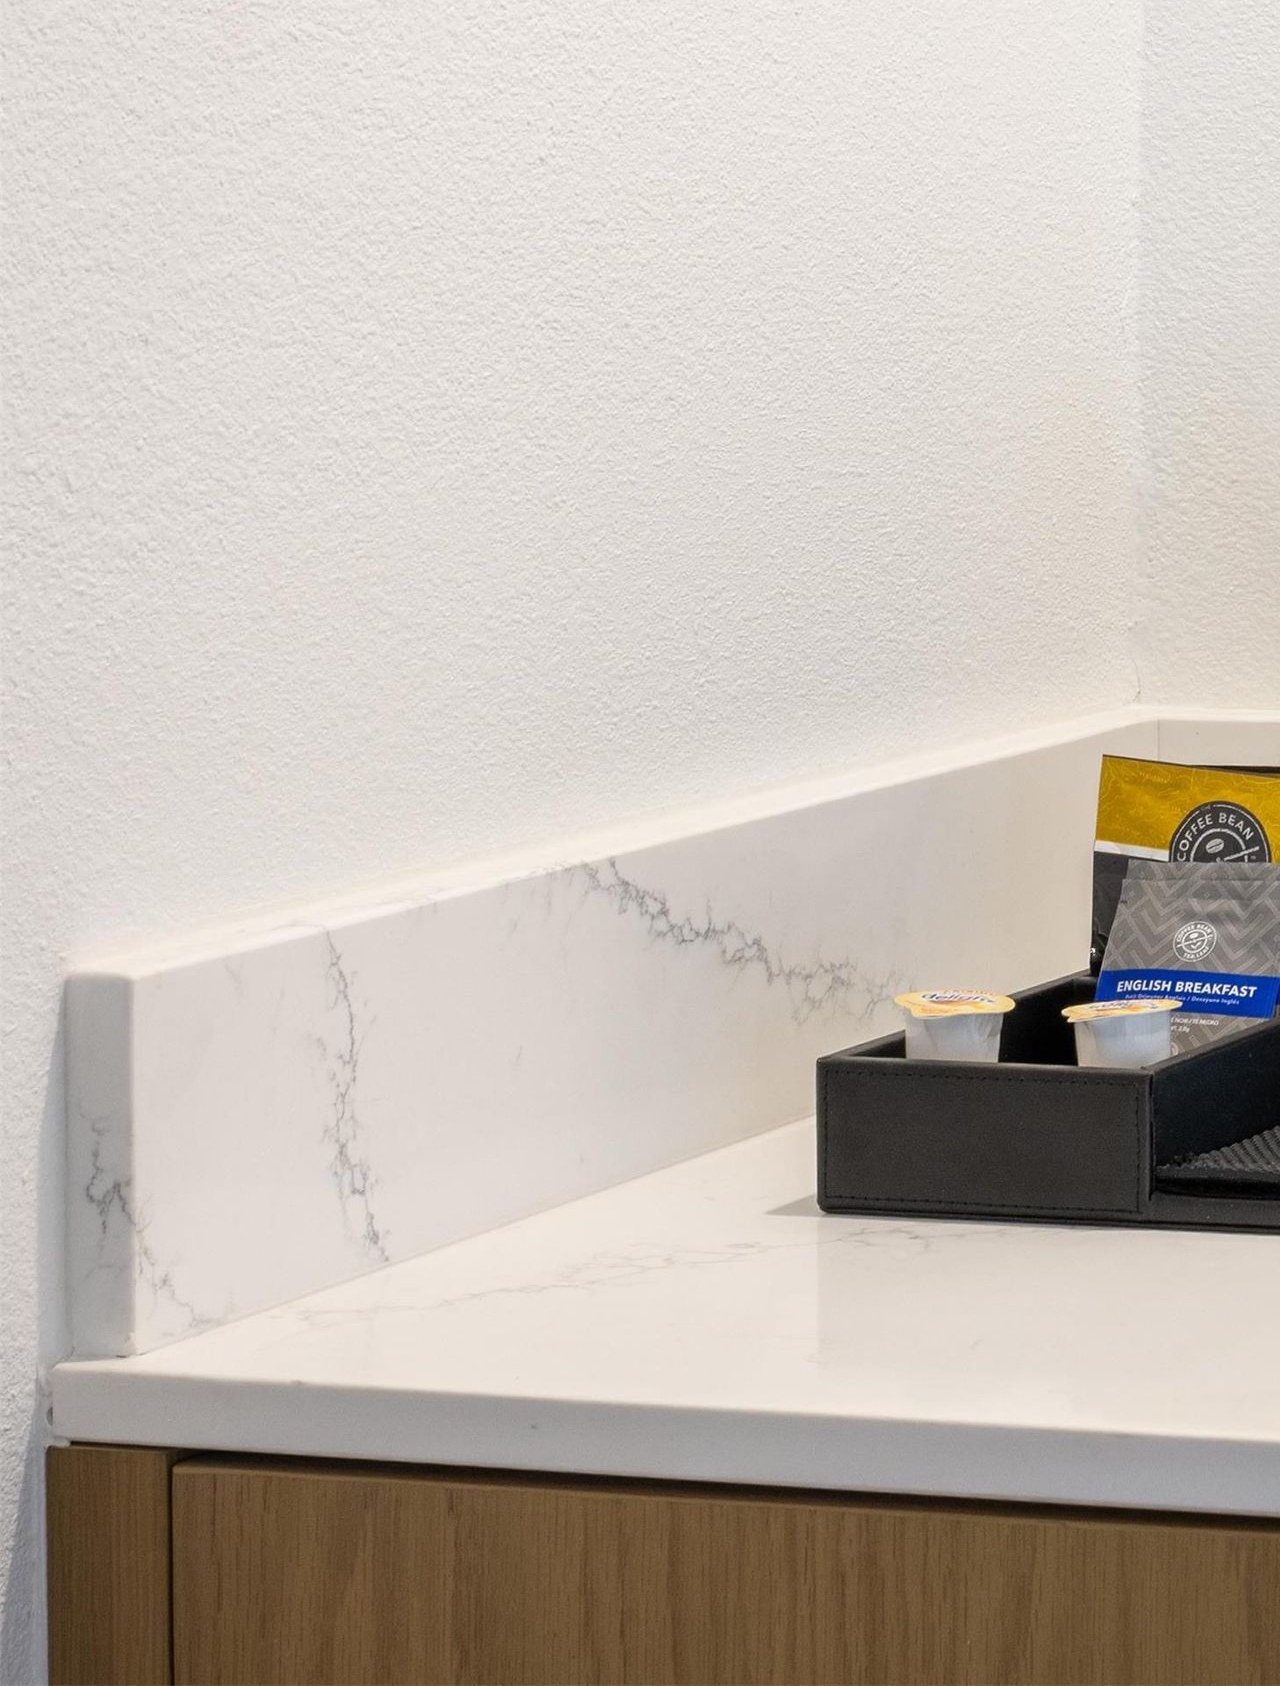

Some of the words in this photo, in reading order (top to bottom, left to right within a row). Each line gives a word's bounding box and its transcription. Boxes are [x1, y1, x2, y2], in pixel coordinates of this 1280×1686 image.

[1177, 813, 1214, 862] COFFEE
[1218, 812, 1255, 841] BEAN
[1117, 979, 1172, 993] ENGLISH
[1175, 981, 1257, 998] BREAKFAST
